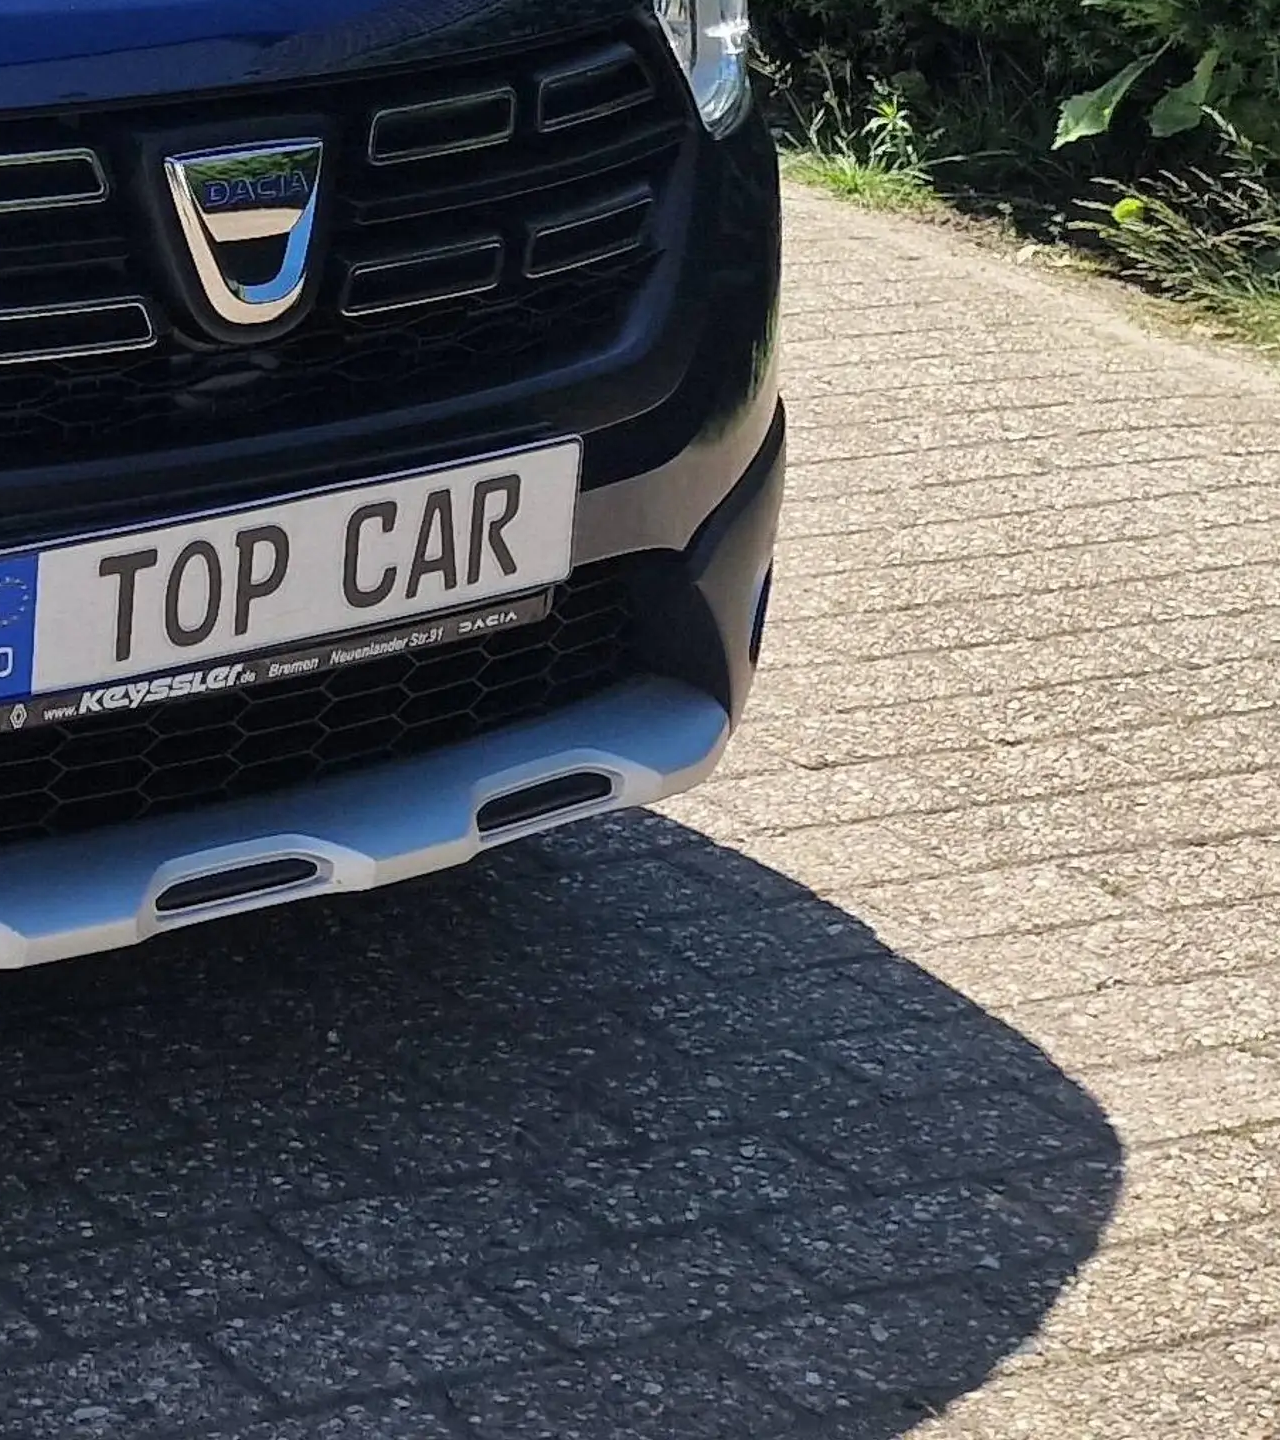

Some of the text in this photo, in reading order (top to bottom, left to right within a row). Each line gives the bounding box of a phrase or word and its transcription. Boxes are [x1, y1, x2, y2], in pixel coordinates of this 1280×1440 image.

[204, 170, 309, 207] DACIA
[99, 474, 521, 661] TOP CAR
[458, 611, 518, 634] DACIA
